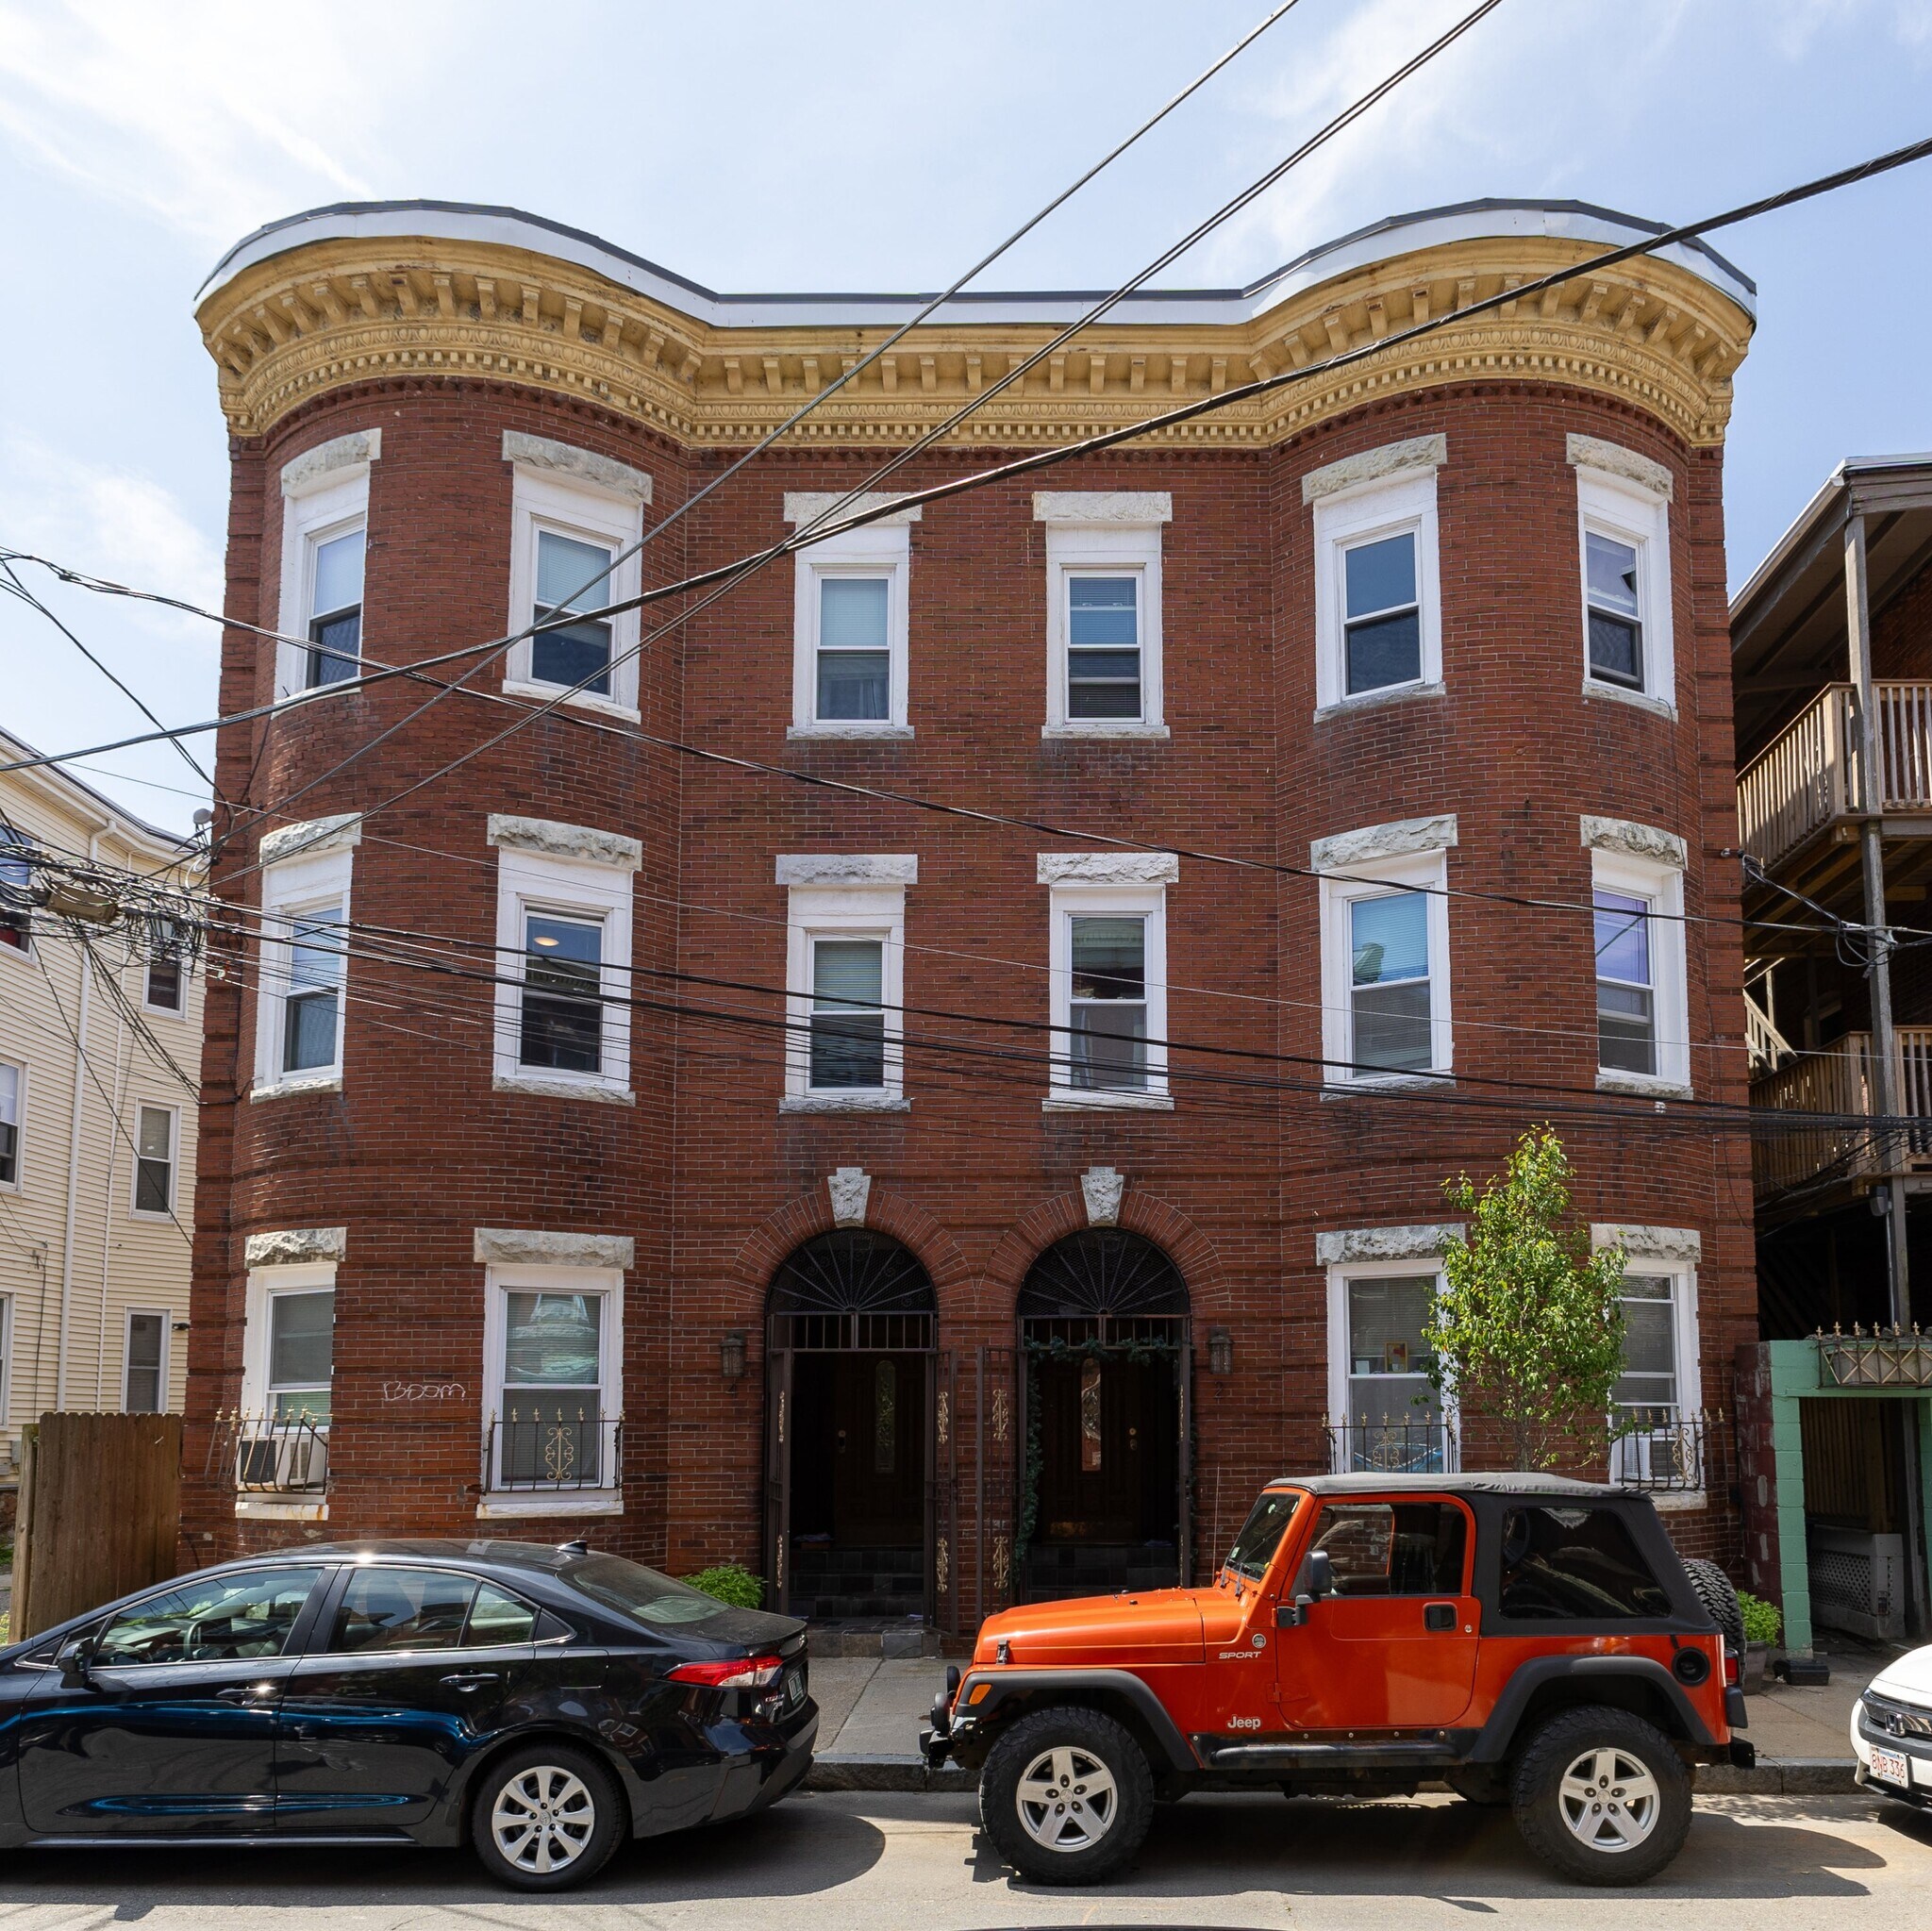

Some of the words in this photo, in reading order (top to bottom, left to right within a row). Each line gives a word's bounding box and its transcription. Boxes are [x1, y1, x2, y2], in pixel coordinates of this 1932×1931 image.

[1214, 1381, 1224, 1399] 2
[1219, 1651, 1261, 1659] SPORT
[1227, 1716, 1261, 1730] Jeep
